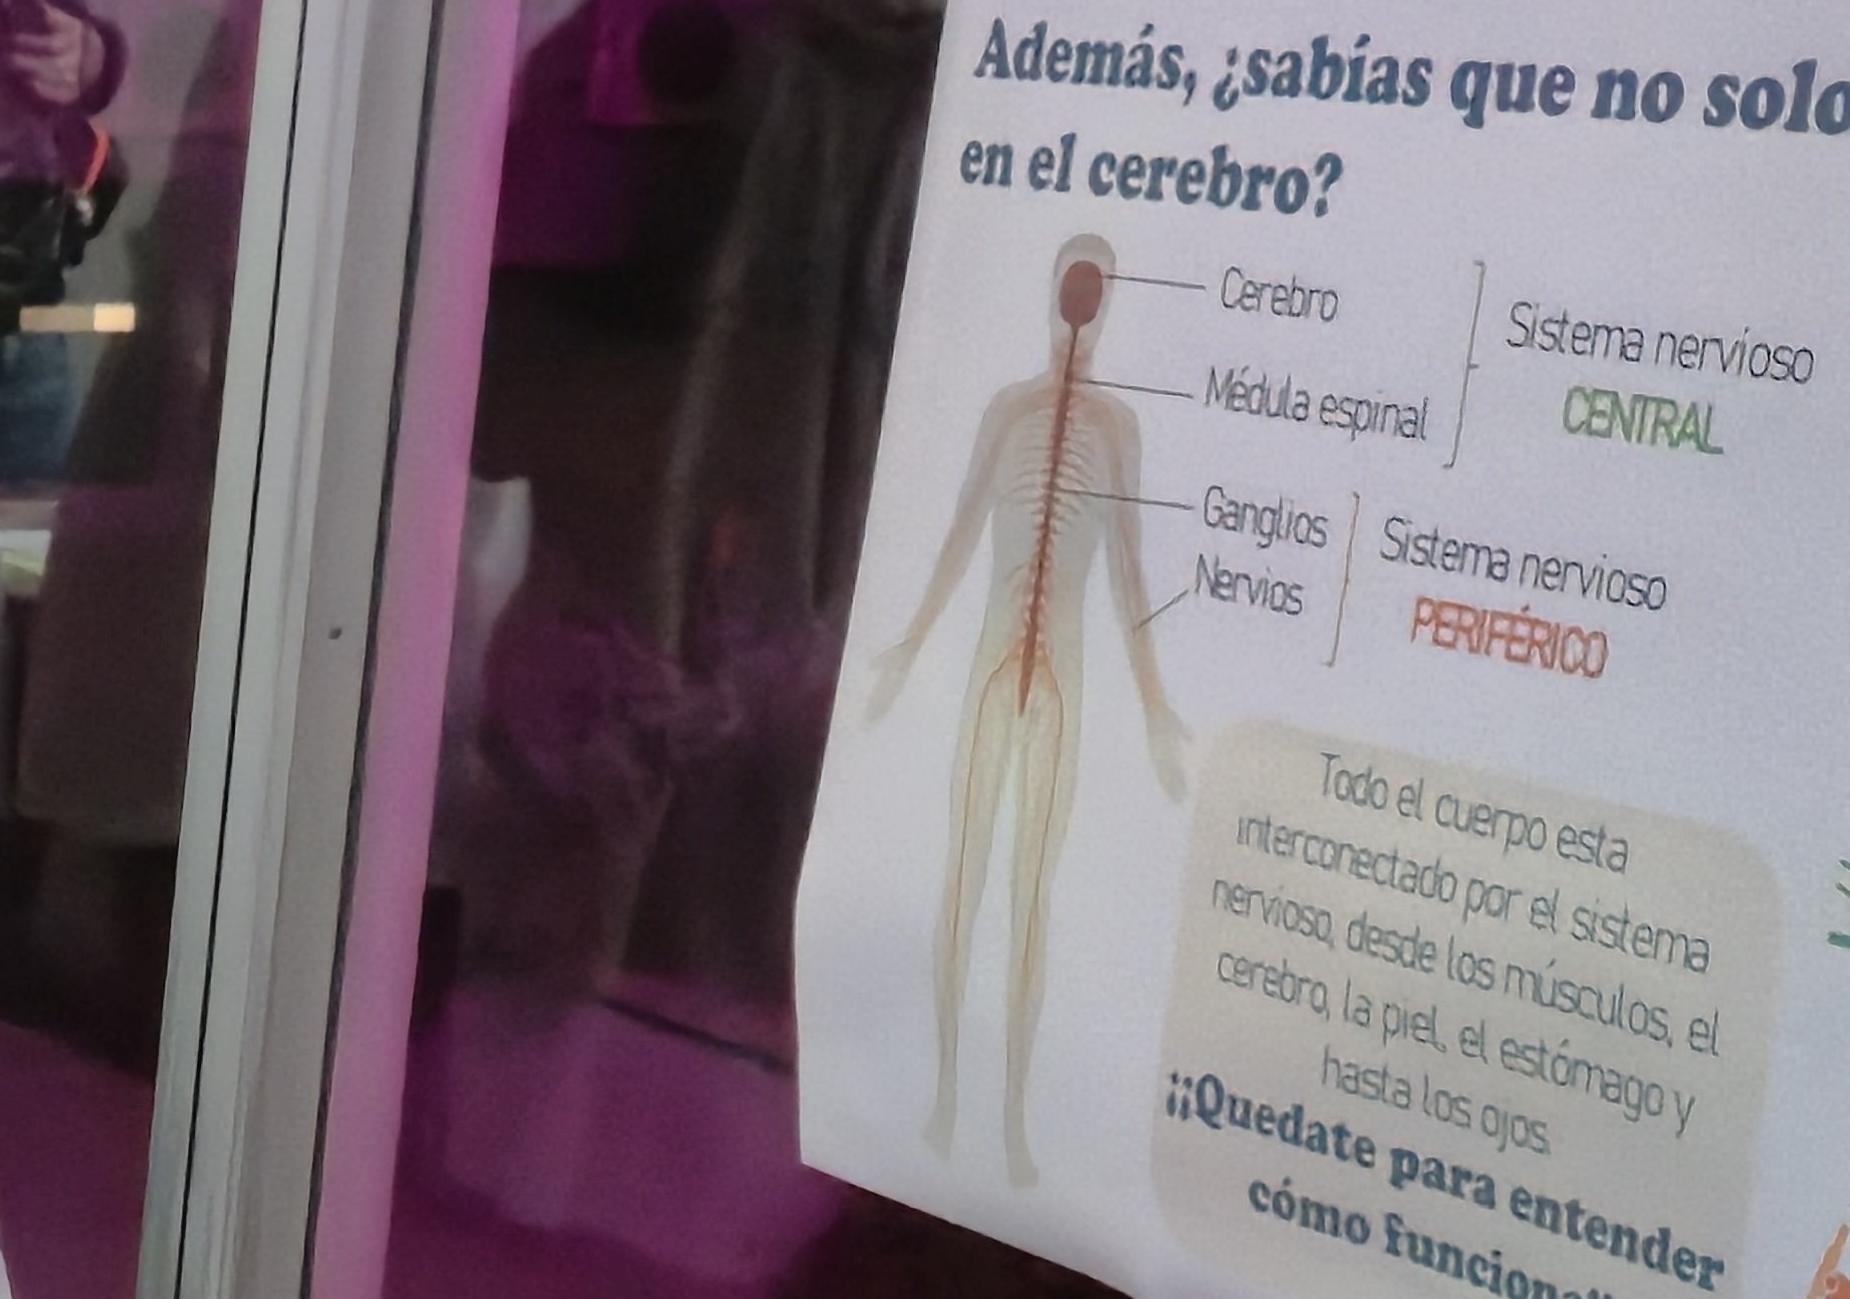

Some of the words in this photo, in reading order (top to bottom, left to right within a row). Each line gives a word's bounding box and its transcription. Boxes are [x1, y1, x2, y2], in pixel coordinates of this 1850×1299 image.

[973, 16, 1197, 107] Además,
[1213, 33, 1434, 112] ¿sabías
[1450, 58, 1576, 130] que
[1590, 68, 1686, 125] no
[1703, 57, 1850, 135] solo
[959, 138, 1013, 187] en
[1028, 132, 1076, 193] el
[1088, 143, 1343, 218] cerebro?
[1220, 266, 1338, 322] Cerebro
[1506, 300, 1644, 363] Sistema
[1654, 326, 1815, 384] nervioso
[1204, 365, 1311, 422] Médula
[1319, 389, 1428, 442] espinal
[1562, 385, 1724, 455] CENTRAL
[1203, 485, 1329, 549] Ganglios
[1195, 553, 1304, 615] Nervios
[1379, 516, 1512, 583] Sistema
[1519, 553, 1668, 610] nervioso
[1410, 595, 1609, 679] PERIFÉRICO
[1320, 751, 1387, 810] Todo
[1397, 778, 1424, 821] el
[1435, 793, 1547, 854] cuerpo
[1556, 823, 1629, 874] esta
[1237, 814, 1459, 903] interconectado
[1462, 877, 1523, 922] por
[1529, 888, 1559, 933] el
[1571, 898, 1710, 973] sistema
[1347, 911, 1437, 974] desde
[1447, 935, 1494, 992] los
[1688, 1008, 1719, 1056] el
[1321, 1044, 1411, 1110] hasta
[1422, 1073, 1471, 1129] los
[1343, 978, 1371, 1027] la
[1459, 1020, 1488, 1064] el
[1500, 1038, 1665, 1123] estómago
[1674, 1094, 1695, 1137] y
[1165, 1071, 1376, 1168] ¡¡Quedate
[1389, 1146, 1497, 1210] para
[1510, 1186, 1724, 1292] entender
[1248, 1176, 1370, 1246] cómo
